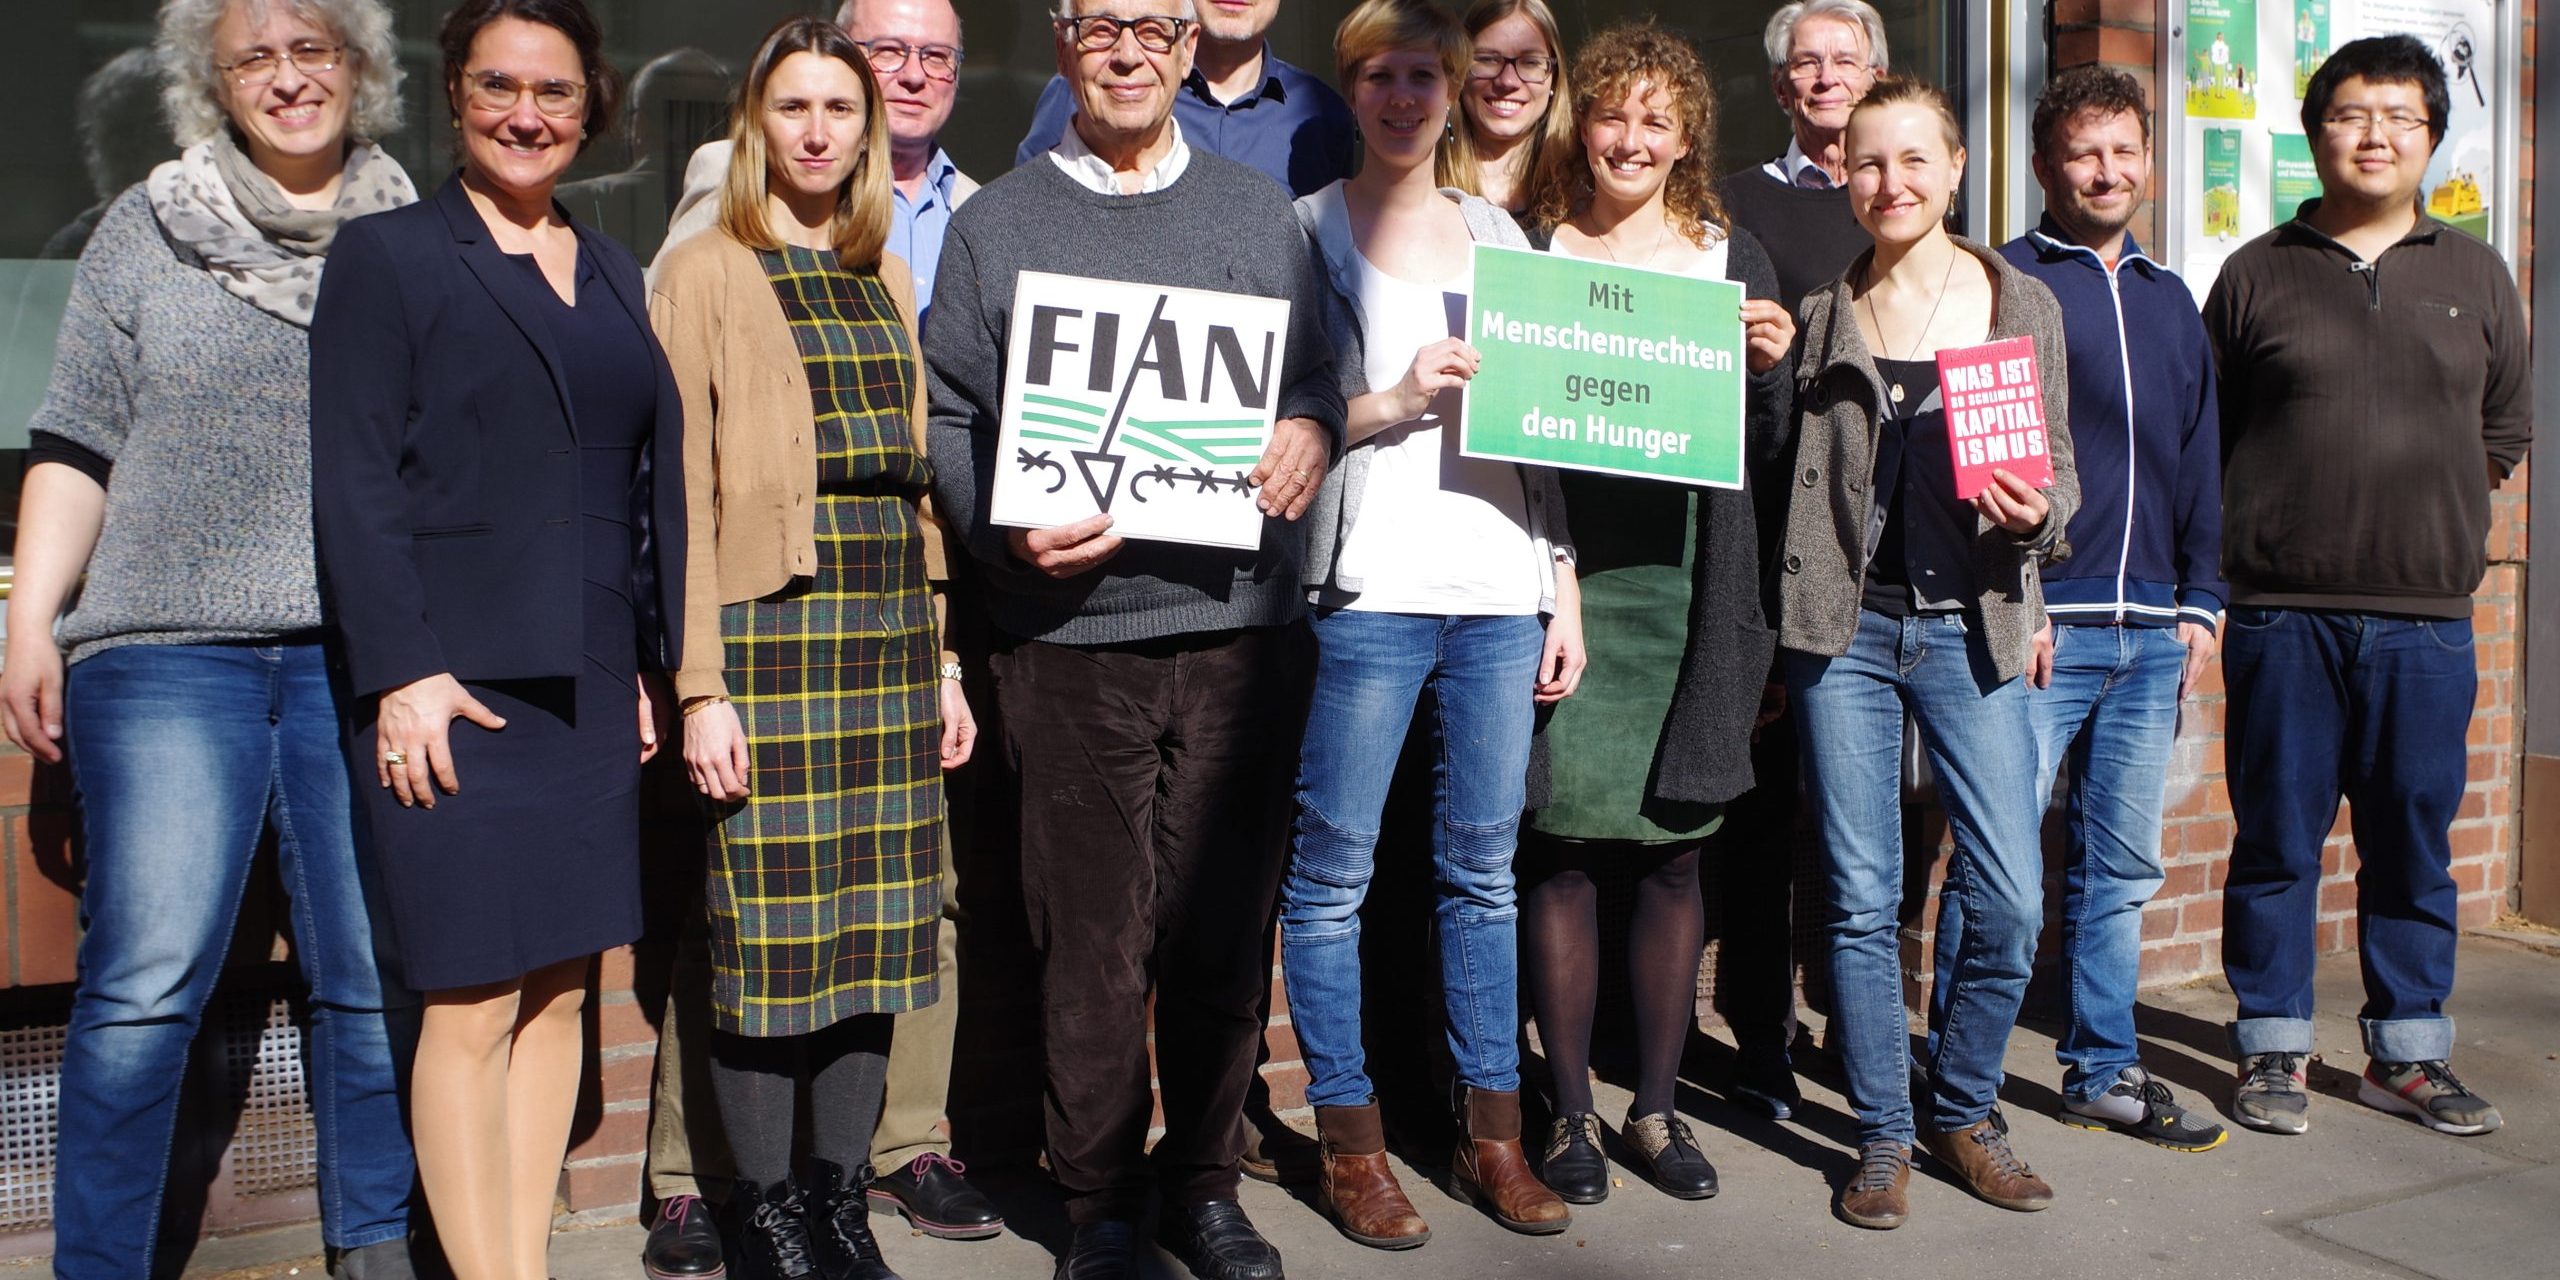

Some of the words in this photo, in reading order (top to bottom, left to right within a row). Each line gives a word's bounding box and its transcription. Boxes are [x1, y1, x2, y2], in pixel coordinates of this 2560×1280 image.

[1588, 281, 1634, 313] Mit
[1025, 294, 1275, 410] FIAN
[1481, 310, 1733, 372] Menschenrechten
[1565, 374, 1651, 407] gegen
[1945, 363, 1995, 394] WAS
[1999, 357, 2032, 386] IST
[1968, 388, 2017, 406] SCHLIMM
[2019, 385, 2035, 399] AM
[1522, 406, 1577, 441] den
[1586, 414, 1691, 458] Hunger
[1953, 400, 2041, 438] KAPITAL
[1956, 429, 2044, 467] ISMUS
